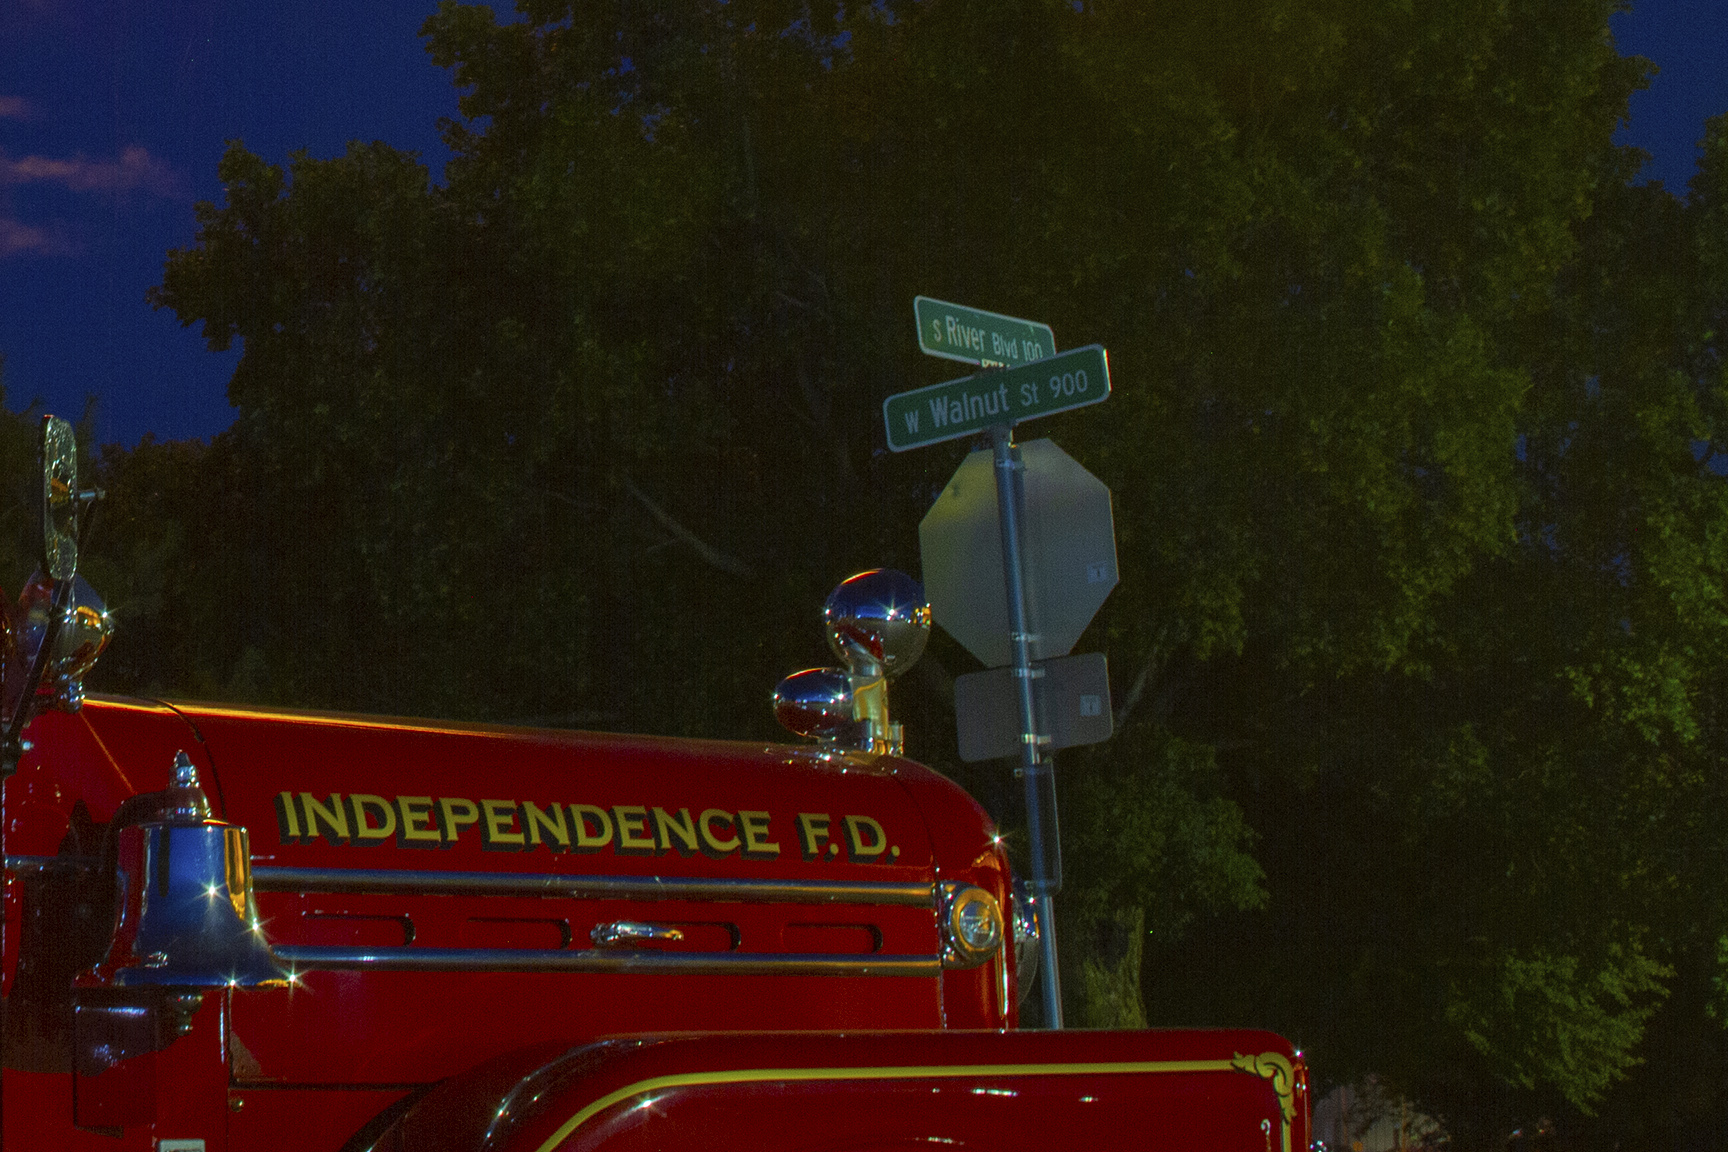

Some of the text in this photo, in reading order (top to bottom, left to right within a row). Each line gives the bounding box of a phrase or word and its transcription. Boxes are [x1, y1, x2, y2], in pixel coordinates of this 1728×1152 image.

[931, 318, 943, 343] S
[945, 315, 987, 353] River
[991, 332, 1019, 360] Blvd
[905, 369, 1089, 435] W Walnut St 900
[278, 790, 902, 859] INDEPENDENCE F.D.
